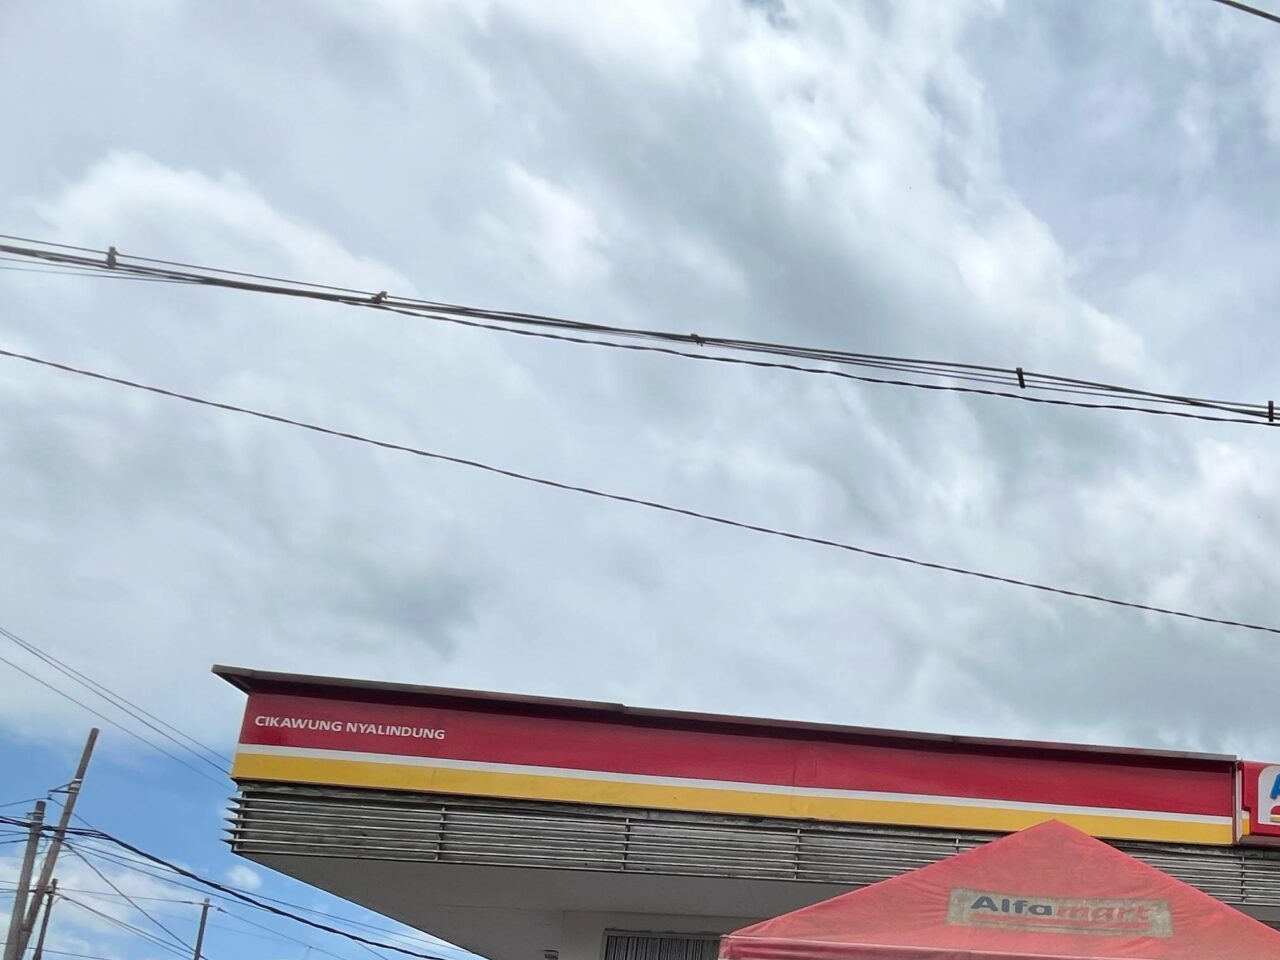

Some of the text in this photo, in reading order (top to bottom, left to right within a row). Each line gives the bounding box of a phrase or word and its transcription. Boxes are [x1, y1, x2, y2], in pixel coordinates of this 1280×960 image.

[255, 715, 446, 740] CIKAWUNG NYALINDUNG
[970, 895, 1150, 921] Alfamart
